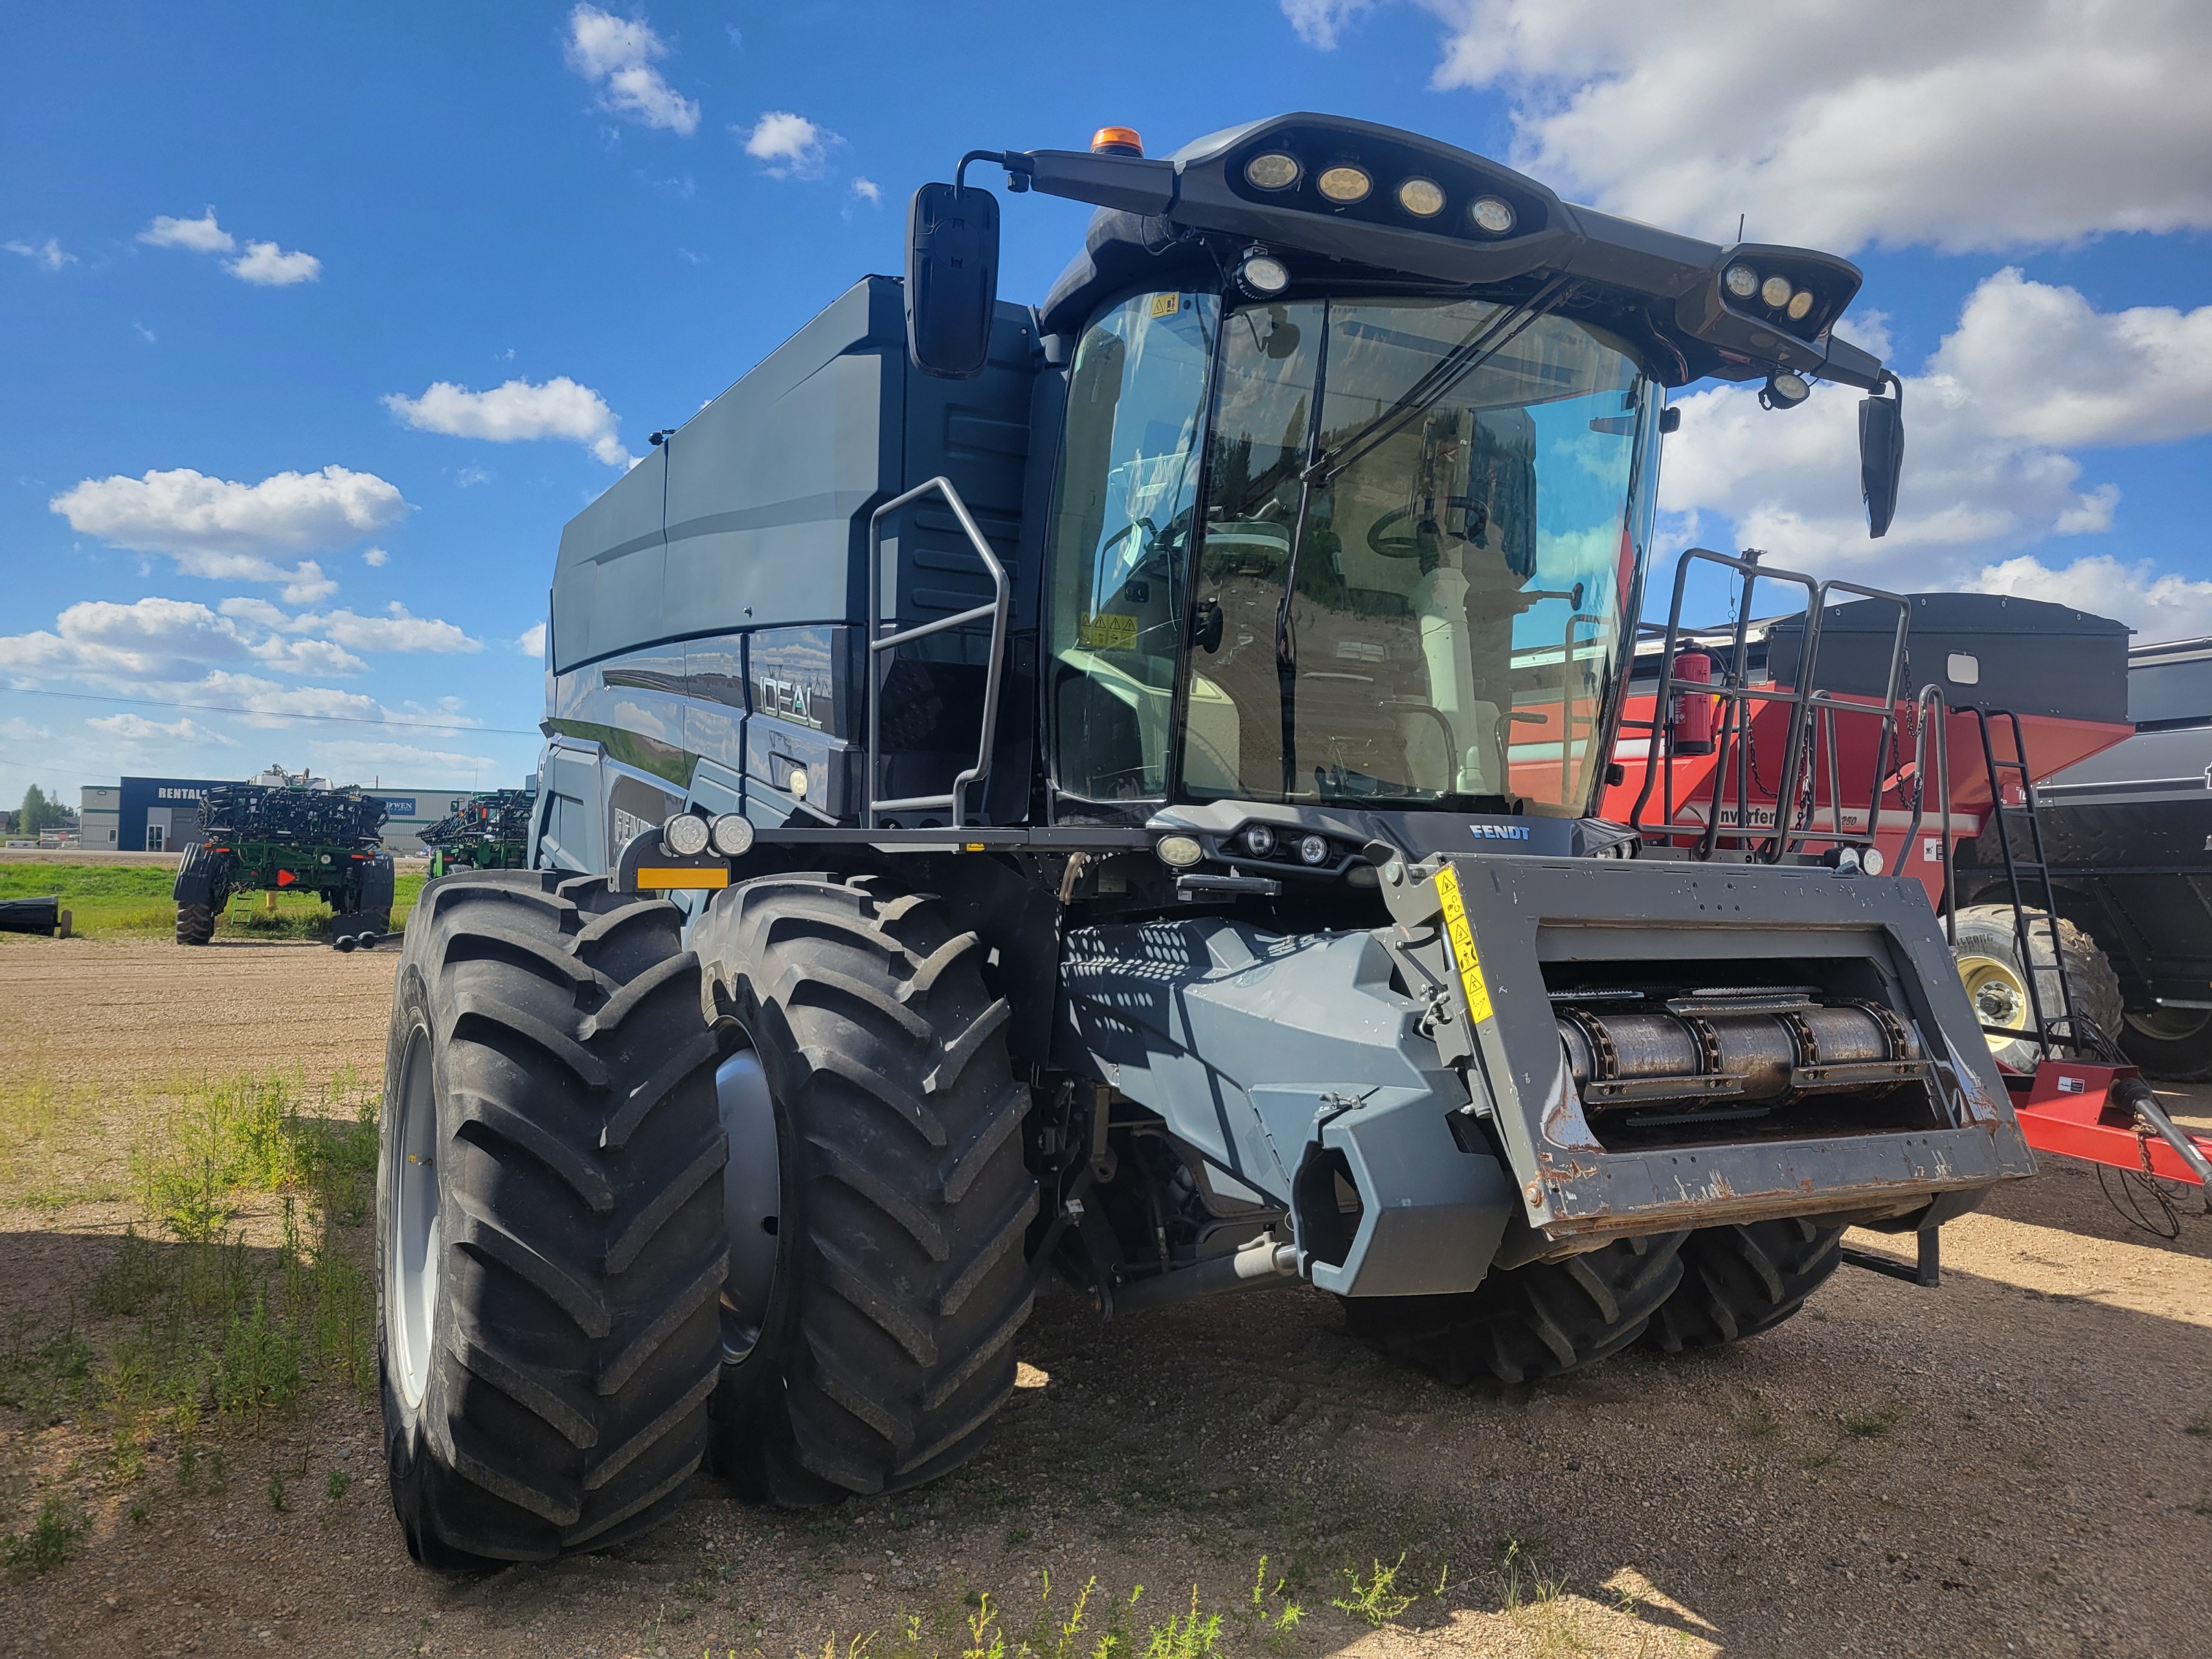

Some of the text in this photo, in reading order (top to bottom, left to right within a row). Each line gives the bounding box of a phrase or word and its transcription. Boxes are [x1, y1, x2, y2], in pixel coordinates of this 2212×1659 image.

[760, 676, 823, 730] IDEAL
[1709, 808, 1776, 824] nvrfer
[1841, 816, 1857, 826] 250
[1469, 824, 1530, 840] FENDT
